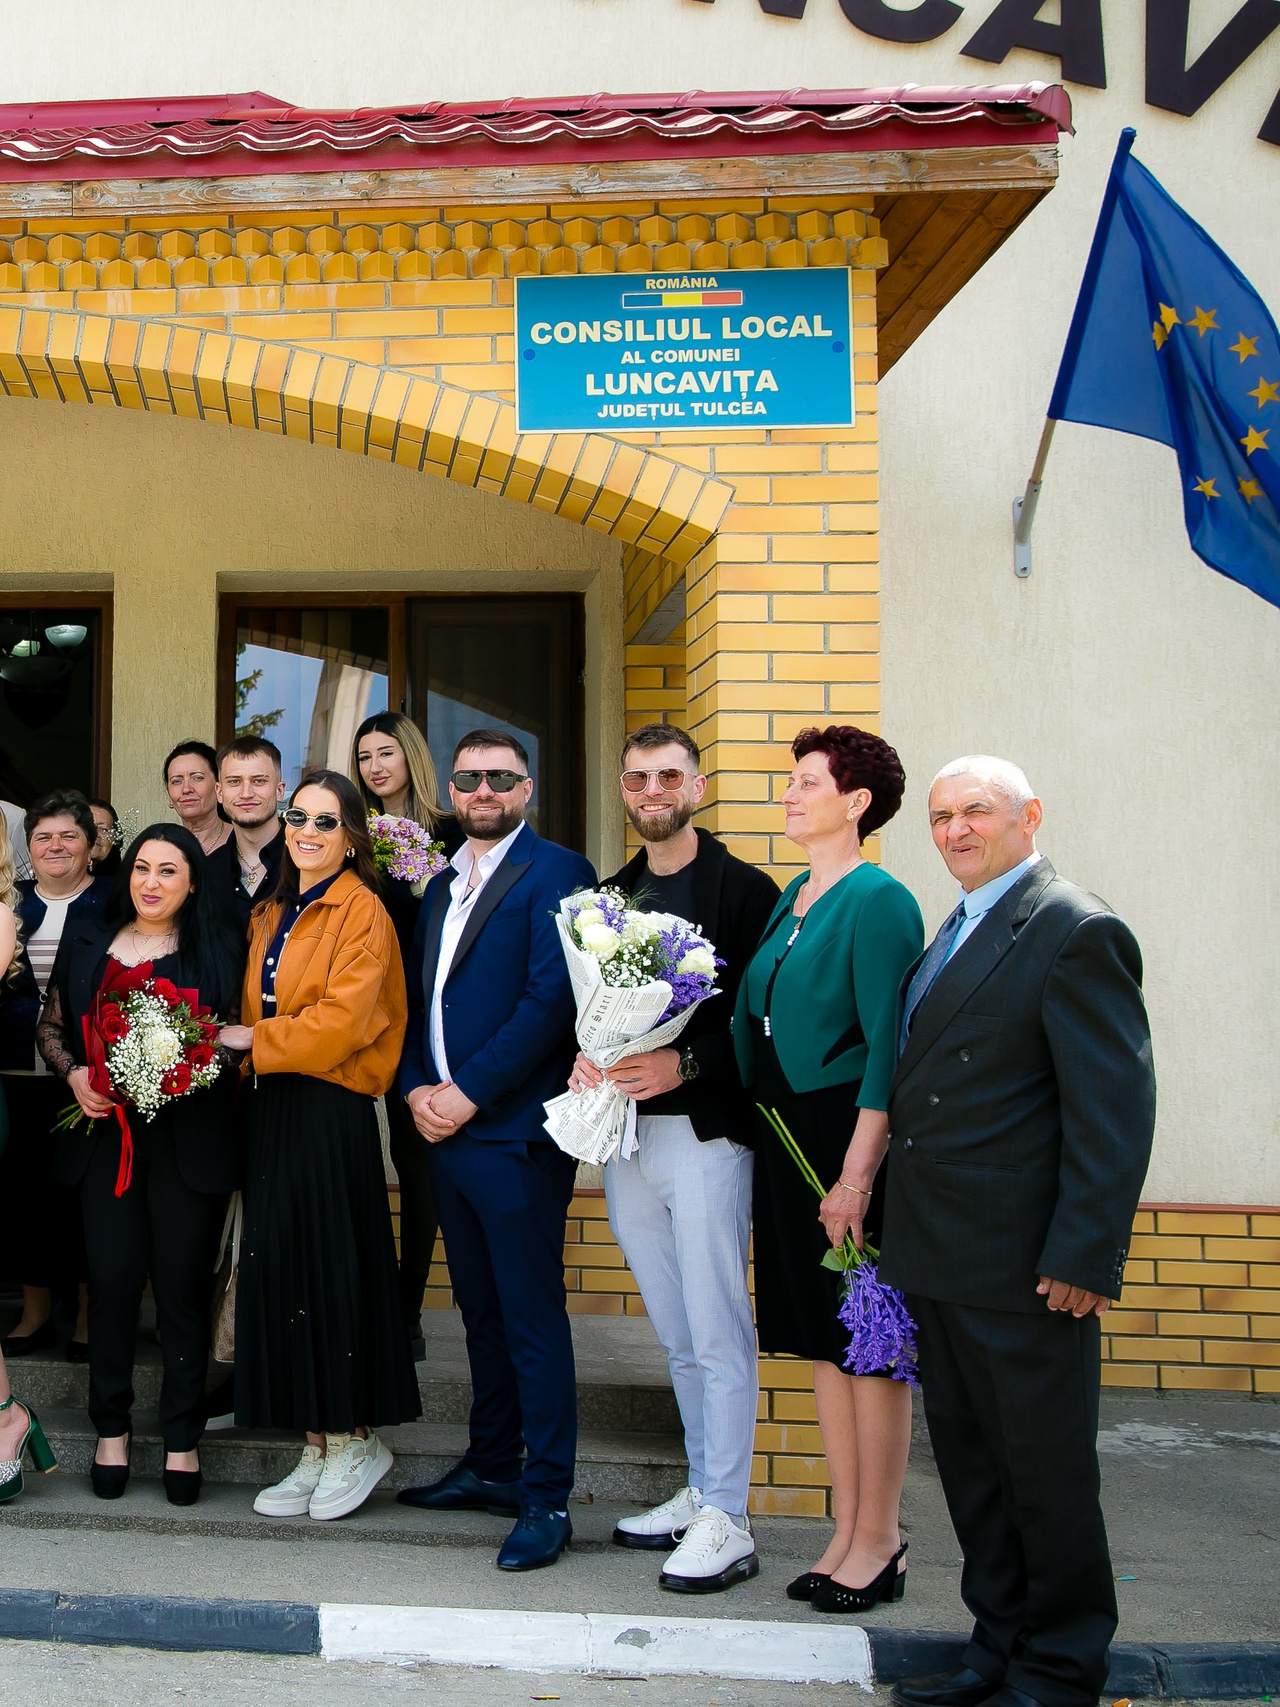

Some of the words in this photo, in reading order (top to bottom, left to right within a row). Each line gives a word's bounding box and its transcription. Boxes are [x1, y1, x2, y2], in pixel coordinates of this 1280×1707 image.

[645, 275, 718, 290] ROMÂNIA
[530, 317, 711, 345] CONSILIUL
[722, 314, 833, 340] LOCAL
[620, 350, 645, 364] AL
[650, 348, 740, 364] COMUNEI
[585, 369, 779, 399] LUNCAVIȚA
[597, 403, 685, 421] JUDEȚUL
[690, 401, 767, 417] TULCEA
